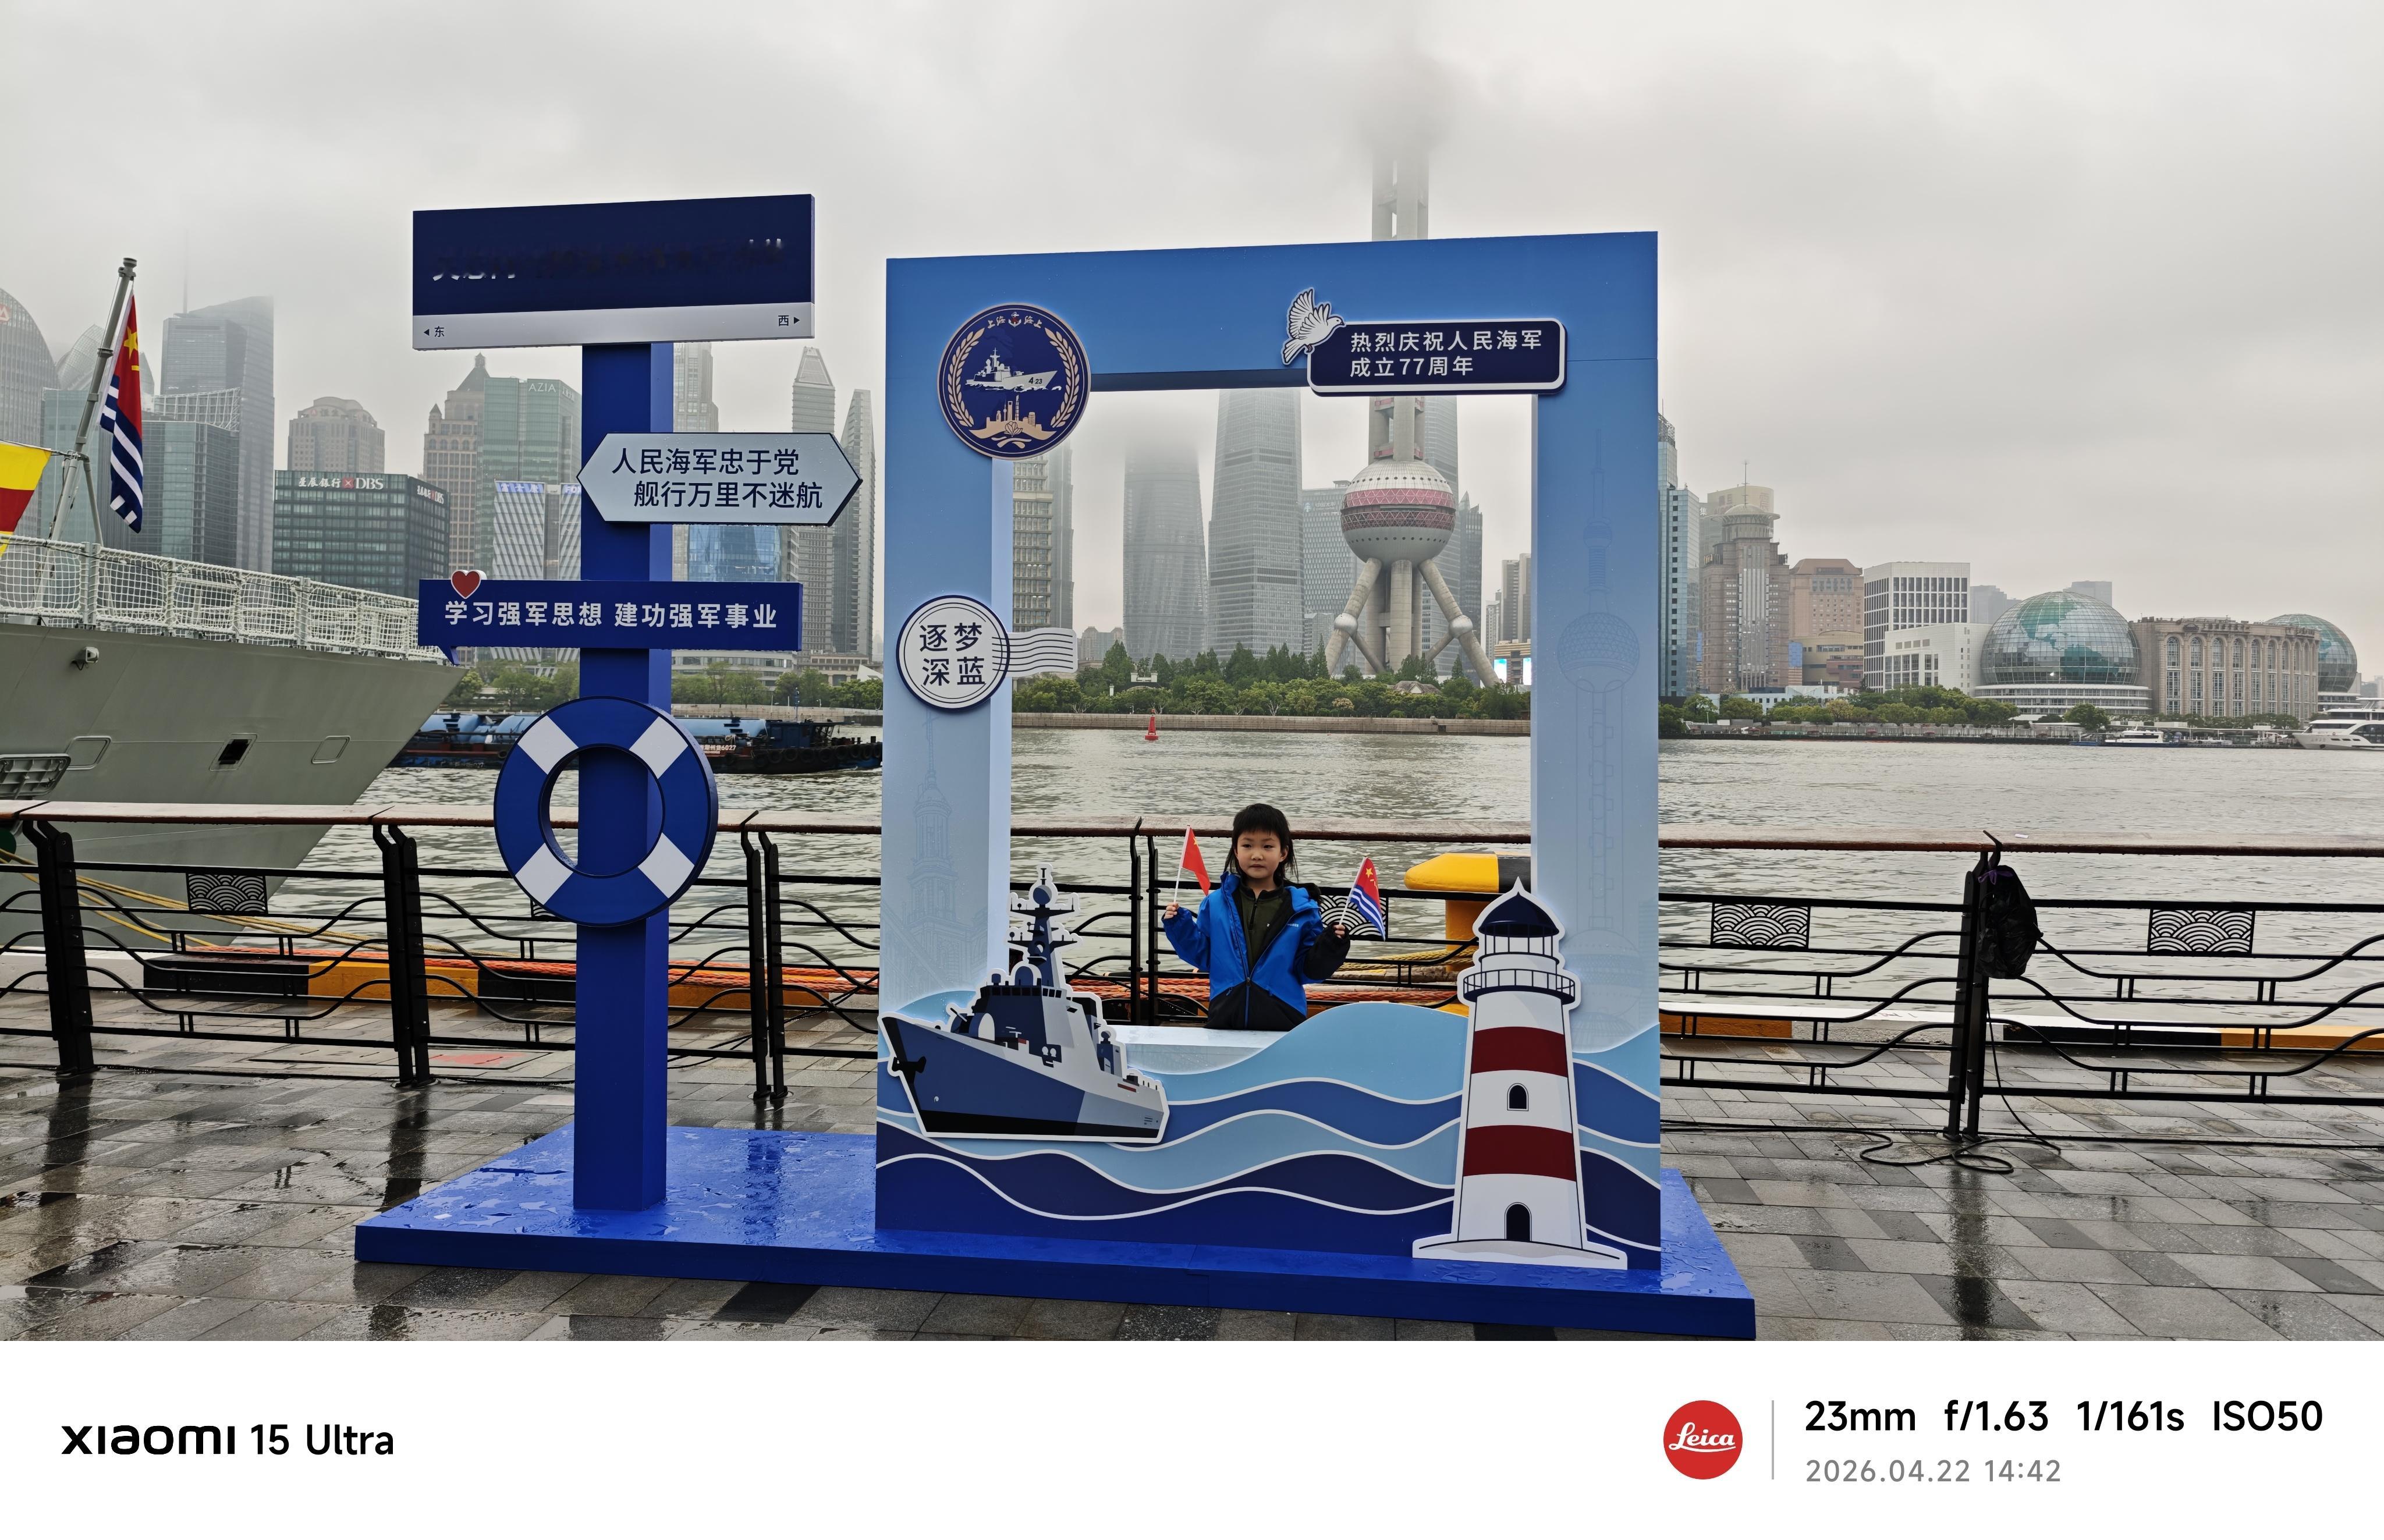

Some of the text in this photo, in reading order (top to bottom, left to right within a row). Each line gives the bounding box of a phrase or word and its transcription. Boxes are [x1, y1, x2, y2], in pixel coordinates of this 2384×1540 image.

[434, 325, 445, 338] 东
[778, 315, 789, 327] 西
[1350, 329, 1542, 353] 热烈庆祝人民海军
[1350, 356, 1474, 377] 成立77周年
[528, 383, 556, 392] AZIA
[612, 448, 800, 476] 人民海军忠于党
[356, 477, 384, 490] DBS
[634, 480, 823, 509] 舰行万里不迷航
[435, 491, 444, 504] DBS
[445, 601, 777, 629] 学习强军思想 建功强军事业
[919, 622, 982, 652] 逐梦
[922, 657, 985, 686] 深蓝
